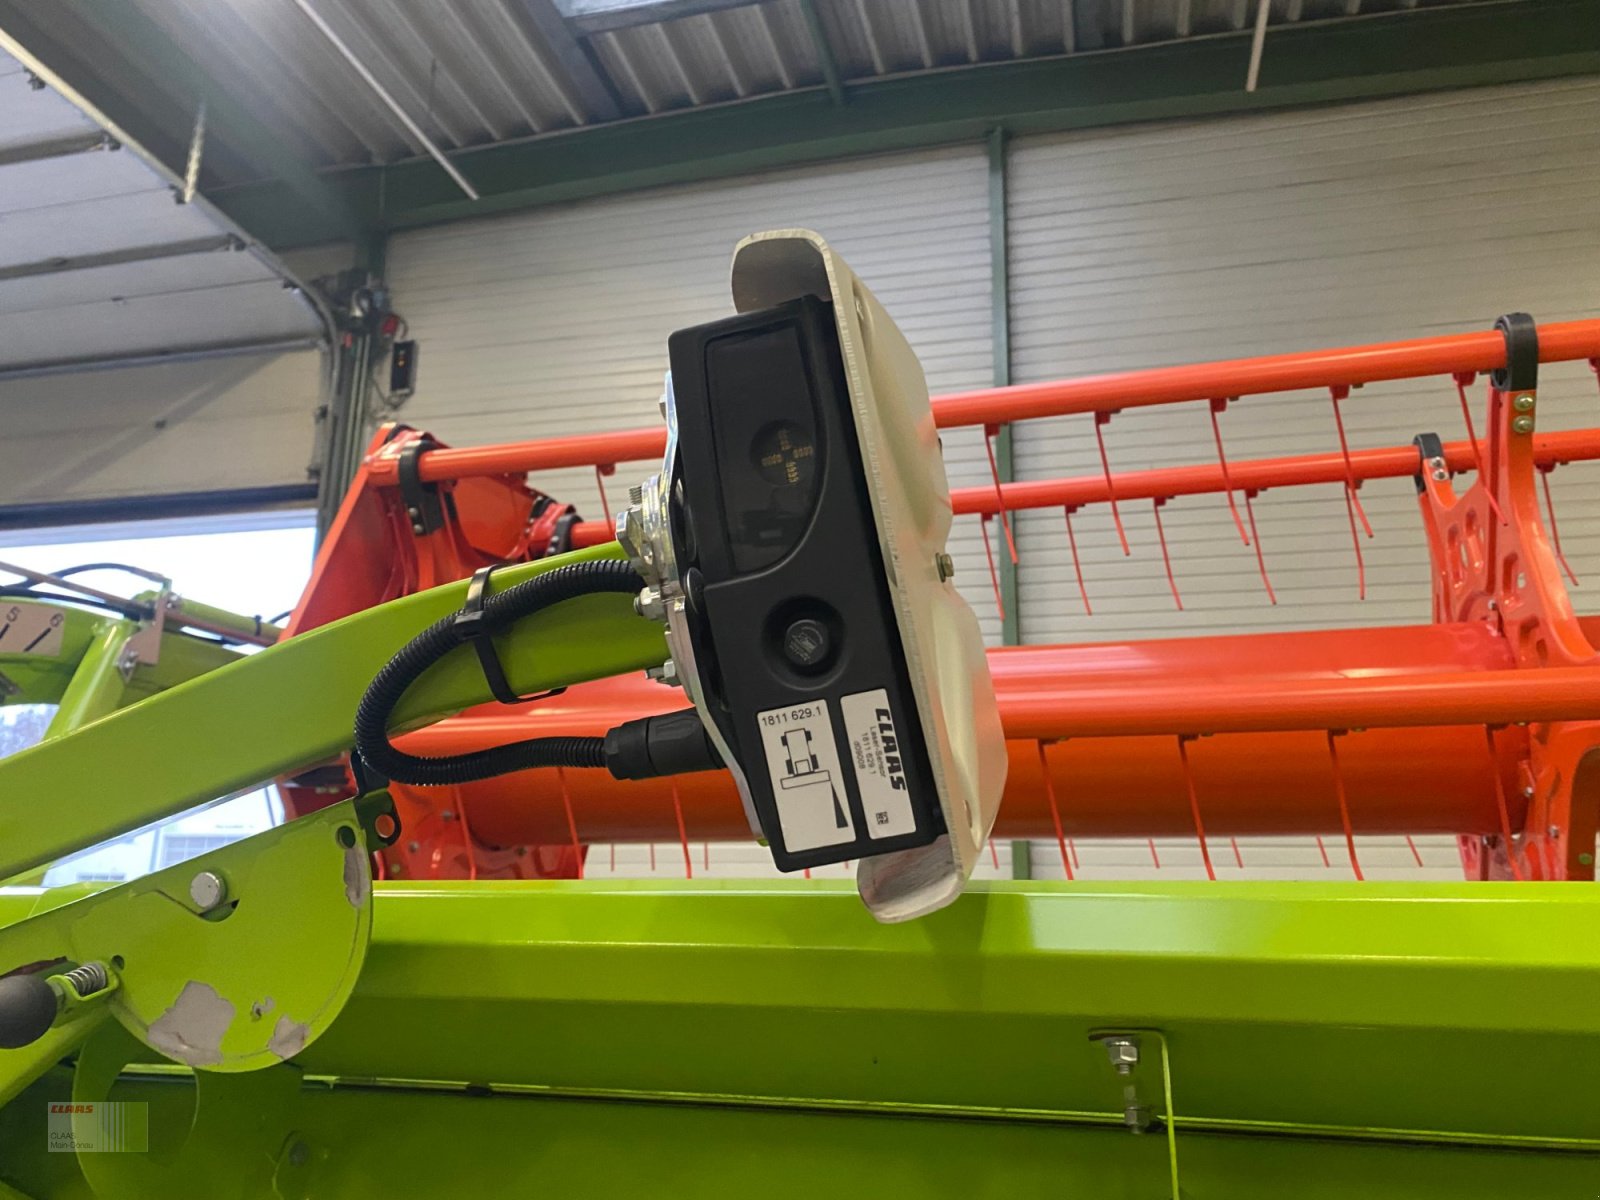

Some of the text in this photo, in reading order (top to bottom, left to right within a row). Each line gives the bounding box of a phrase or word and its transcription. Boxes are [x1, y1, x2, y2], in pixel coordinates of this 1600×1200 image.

[6, 606, 21, 622] 5
[50, 613, 64, 627] 6
[762, 706, 821, 726] 1811 629.1
[870, 725, 886, 777] Laser-Sensor
[875, 708, 907, 791] CLAAS
